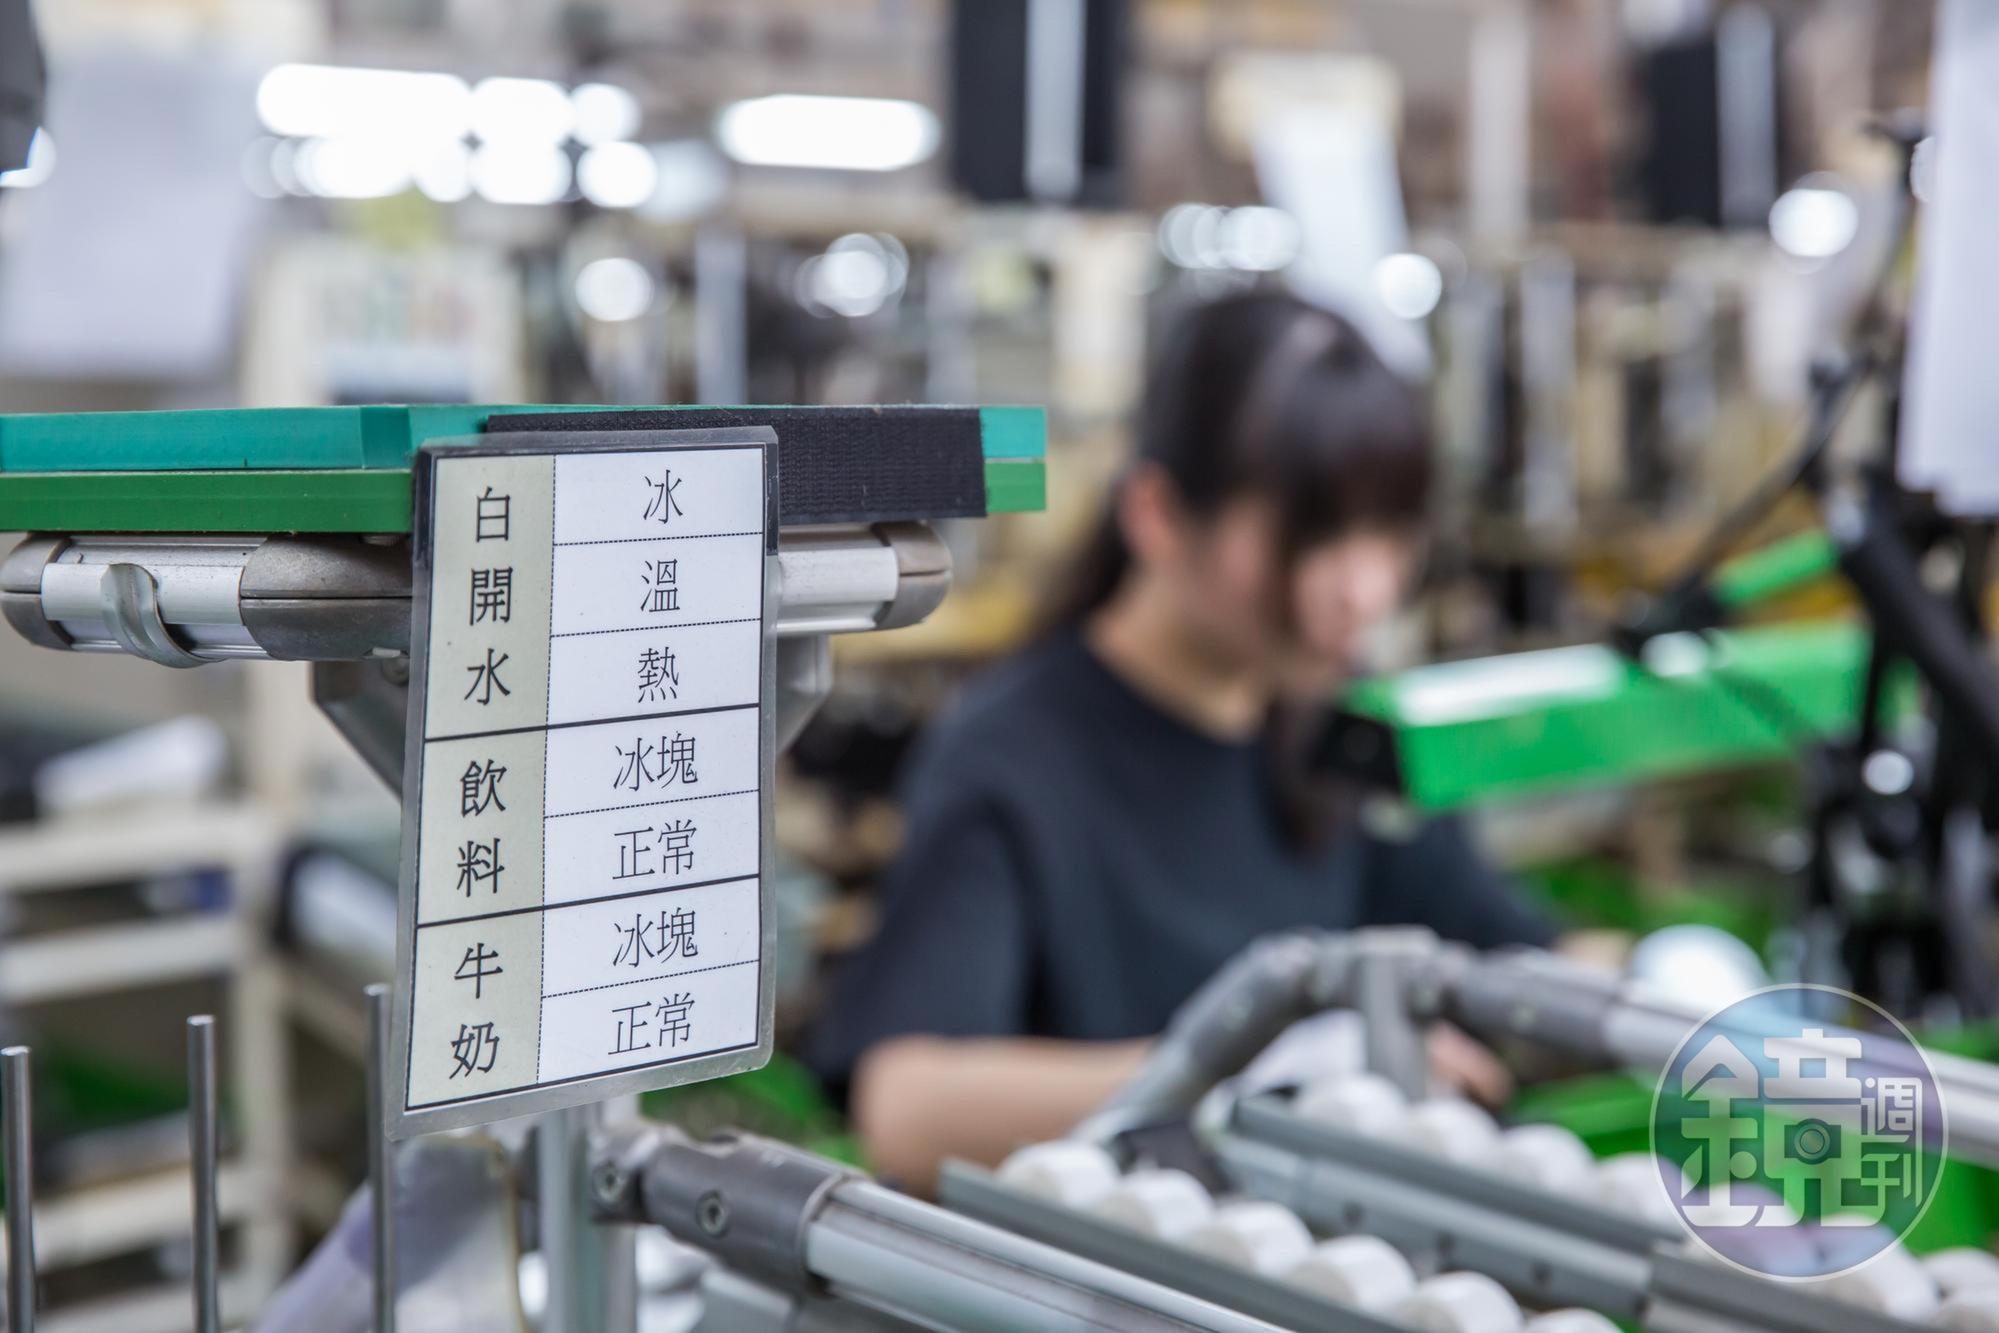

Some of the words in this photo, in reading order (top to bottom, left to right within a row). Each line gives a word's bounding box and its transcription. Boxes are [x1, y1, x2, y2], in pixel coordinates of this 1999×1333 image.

[643, 469, 684, 525] 冰
[463, 485, 514, 706] 白開水
[640, 558, 681, 613] 溫
[637, 646, 680, 703] 熱
[612, 732, 699, 792] 冰塊
[456, 758, 507, 898] 飲料
[612, 819, 697, 880] 正常
[612, 907, 699, 968] 冰塊
[449, 942, 503, 1080] 牛奶
[607, 992, 695, 1056] 正常
